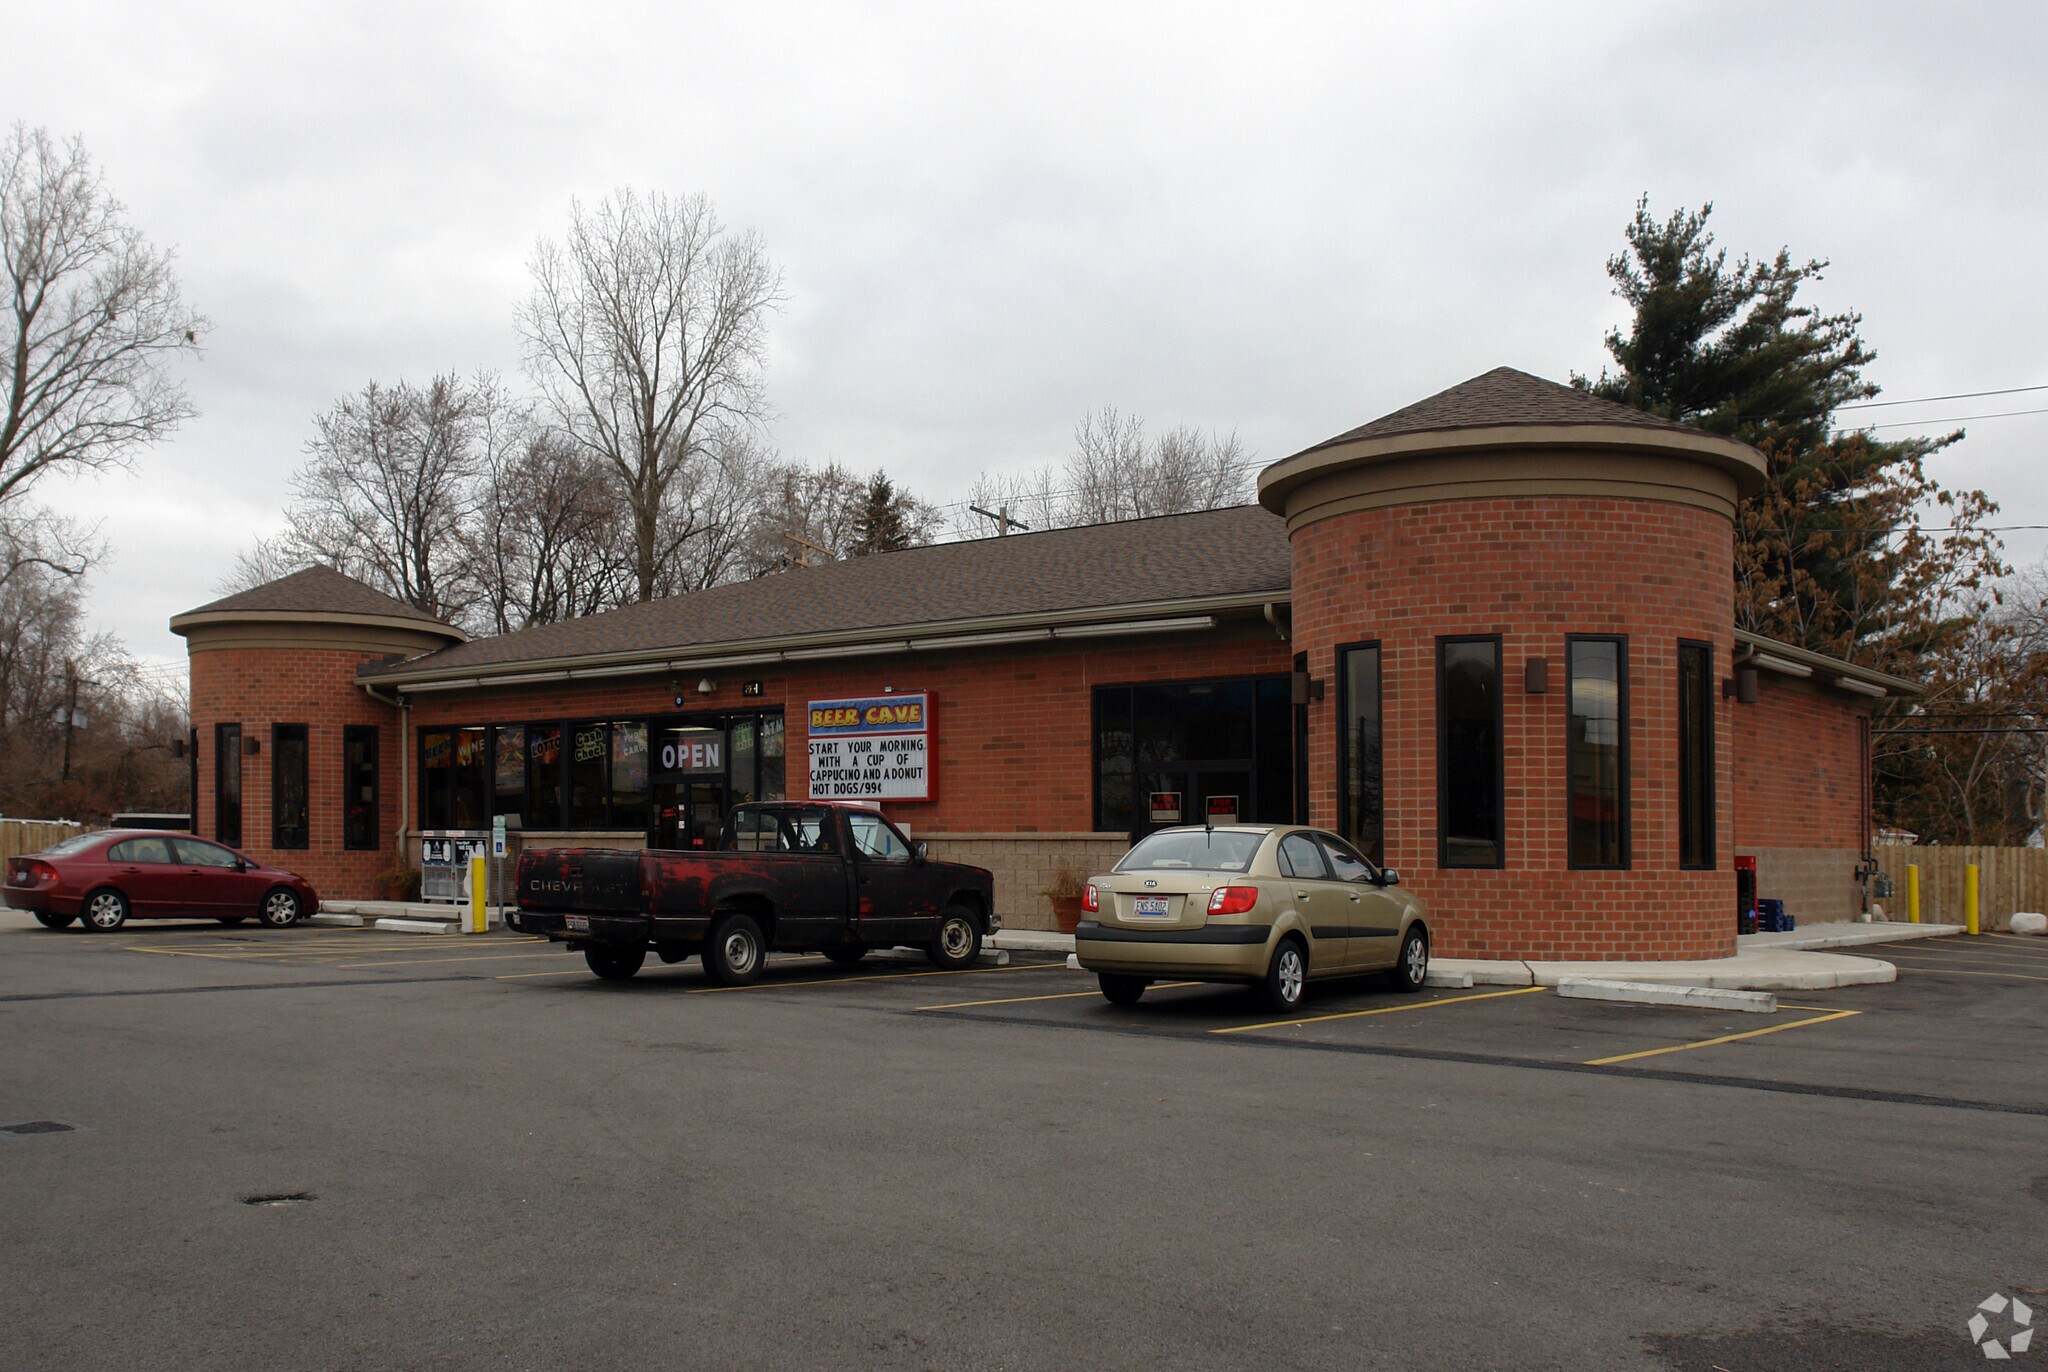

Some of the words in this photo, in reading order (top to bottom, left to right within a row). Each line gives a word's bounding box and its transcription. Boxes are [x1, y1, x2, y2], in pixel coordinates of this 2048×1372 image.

[811, 707, 860, 728] BEER
[865, 703, 922, 725] CAVE
[763, 717, 784, 737] ATM
[576, 728, 602, 747] Cash
[457, 738, 484, 756] WINE
[530, 735, 560, 758] LOTTO
[809, 742, 839, 755] START
[848, 741, 872, 753] YOUR
[880, 739, 923, 753] MORNING
[662, 744, 719, 769] OPEN
[818, 756, 841, 768] WITH
[852, 756, 859, 767] A
[867, 754, 885, 766] CUP
[896, 754, 909, 765] OF
[810, 768, 861, 782] CAPPUCINO
[863, 768, 881, 780] AND
[884, 768, 890, 780] A
[891, 767, 923, 780] DONUT
[812, 783, 830, 795] HOT
[1208, 806, 1235, 814] RENT
[1213, 798, 1231, 806] FOR
